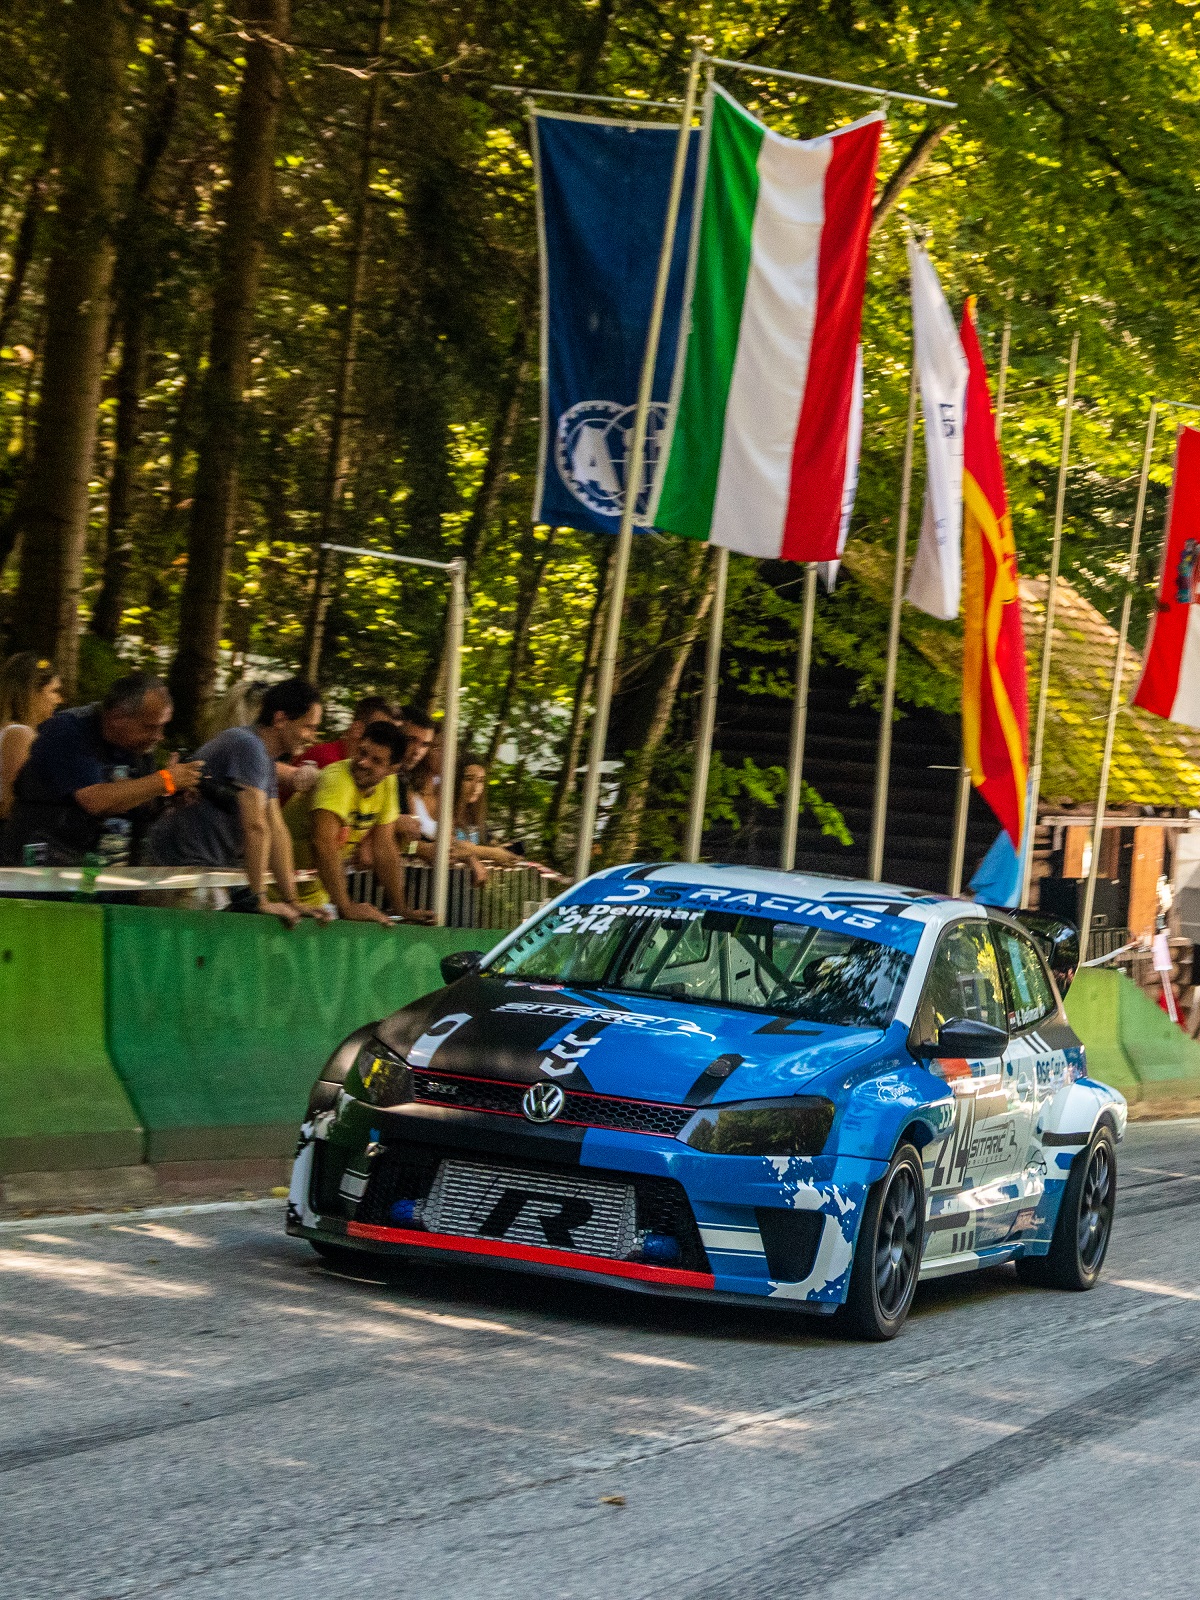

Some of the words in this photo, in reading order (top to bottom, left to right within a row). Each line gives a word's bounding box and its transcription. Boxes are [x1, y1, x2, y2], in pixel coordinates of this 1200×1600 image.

[588, 904, 705, 922] Delimar
[689, 888, 882, 930] RACING
[551, 914, 611, 934] 214
